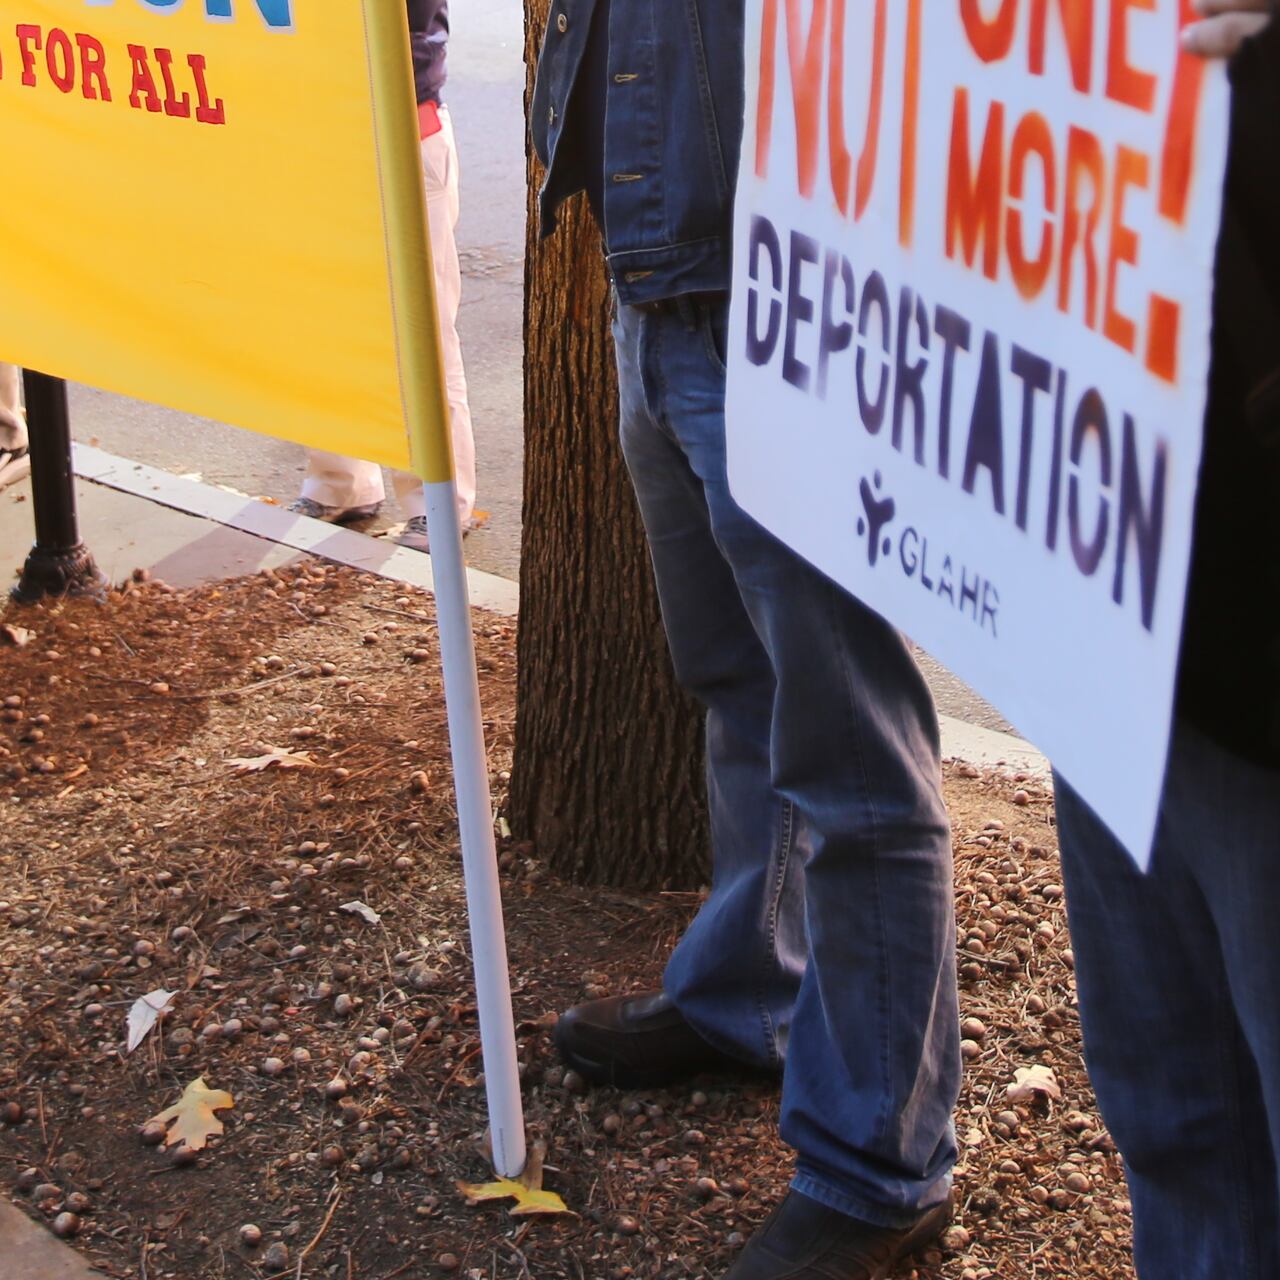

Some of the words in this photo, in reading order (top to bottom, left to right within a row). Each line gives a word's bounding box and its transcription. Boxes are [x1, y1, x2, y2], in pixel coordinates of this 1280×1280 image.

[16, 24, 111, 102] FOR
[127, 43, 225, 125] ALL
[745, 214, 1168, 634] DEPORTATION
[899, 526, 1000, 639] GLAHR
